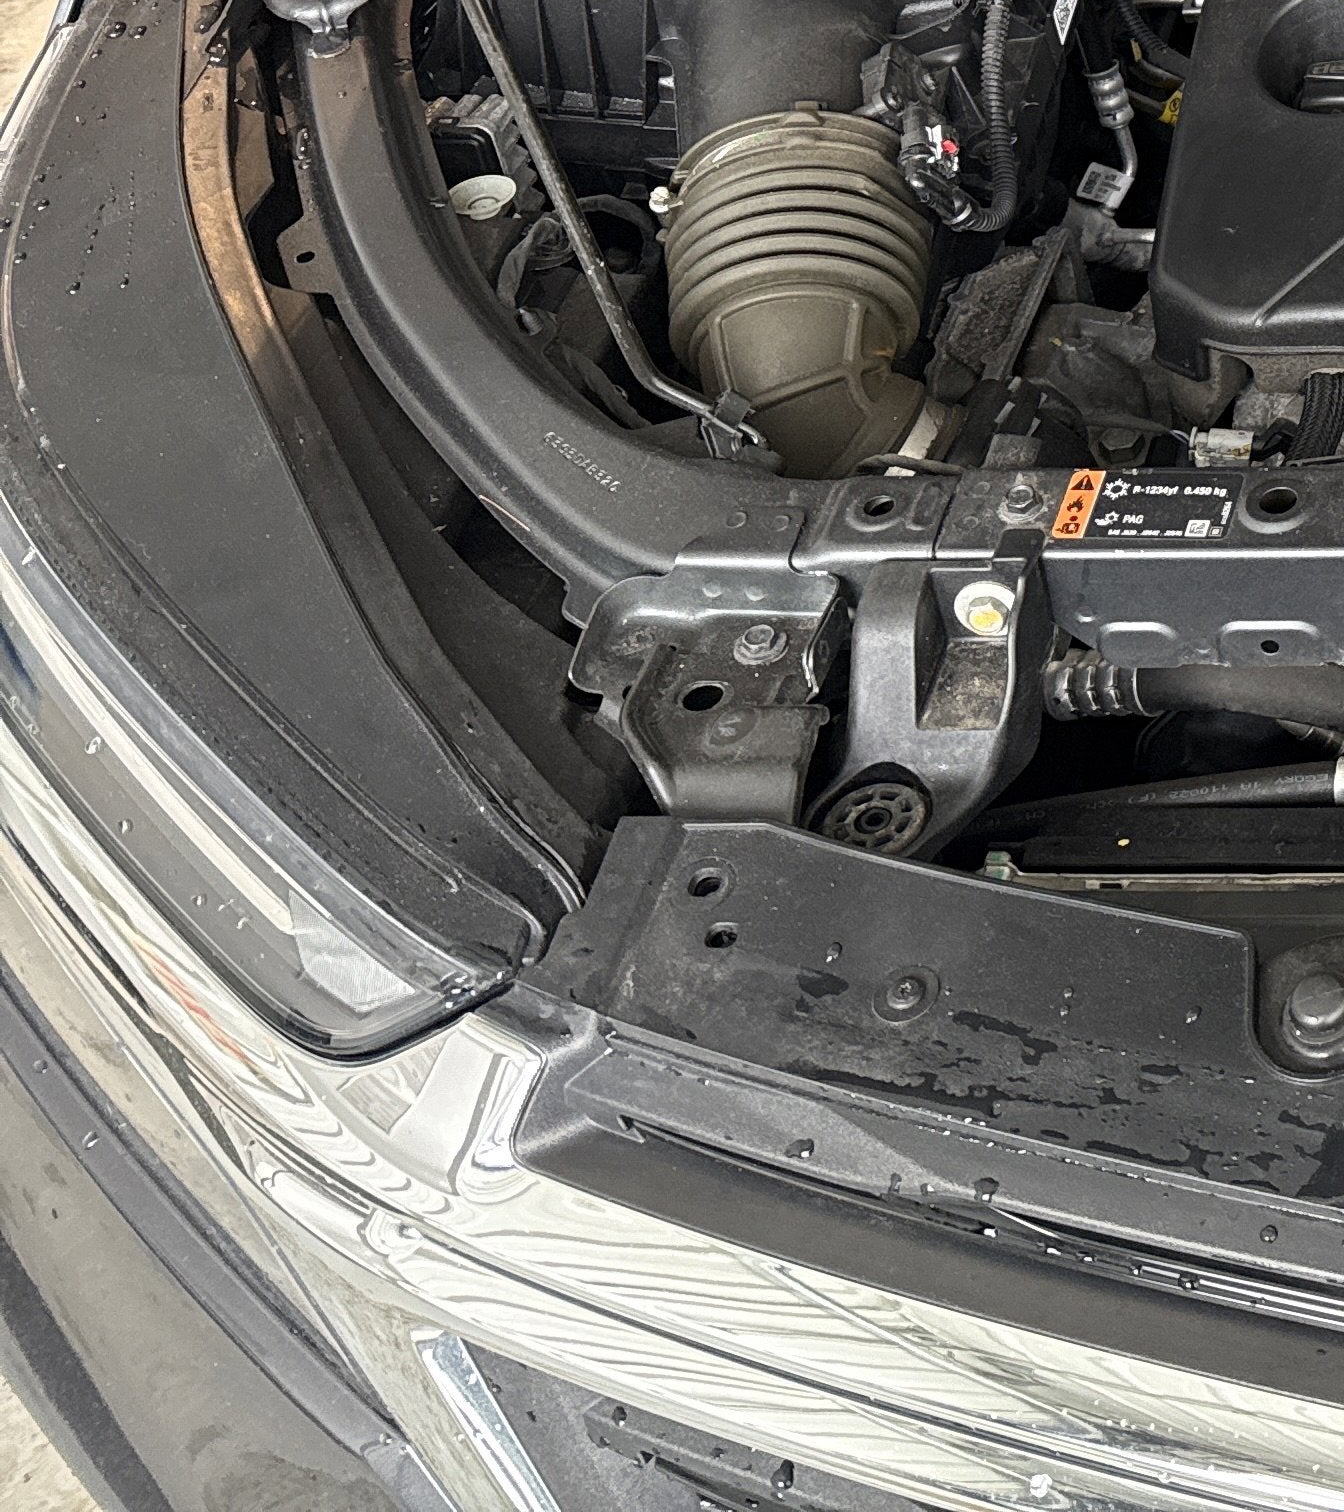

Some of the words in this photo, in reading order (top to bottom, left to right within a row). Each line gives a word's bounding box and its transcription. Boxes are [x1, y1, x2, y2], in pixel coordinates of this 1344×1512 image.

[1132, 485, 1179, 497] R-1234yf
[1213, 487, 1228, 497] kg
[1122, 514, 1144, 524] PAG
